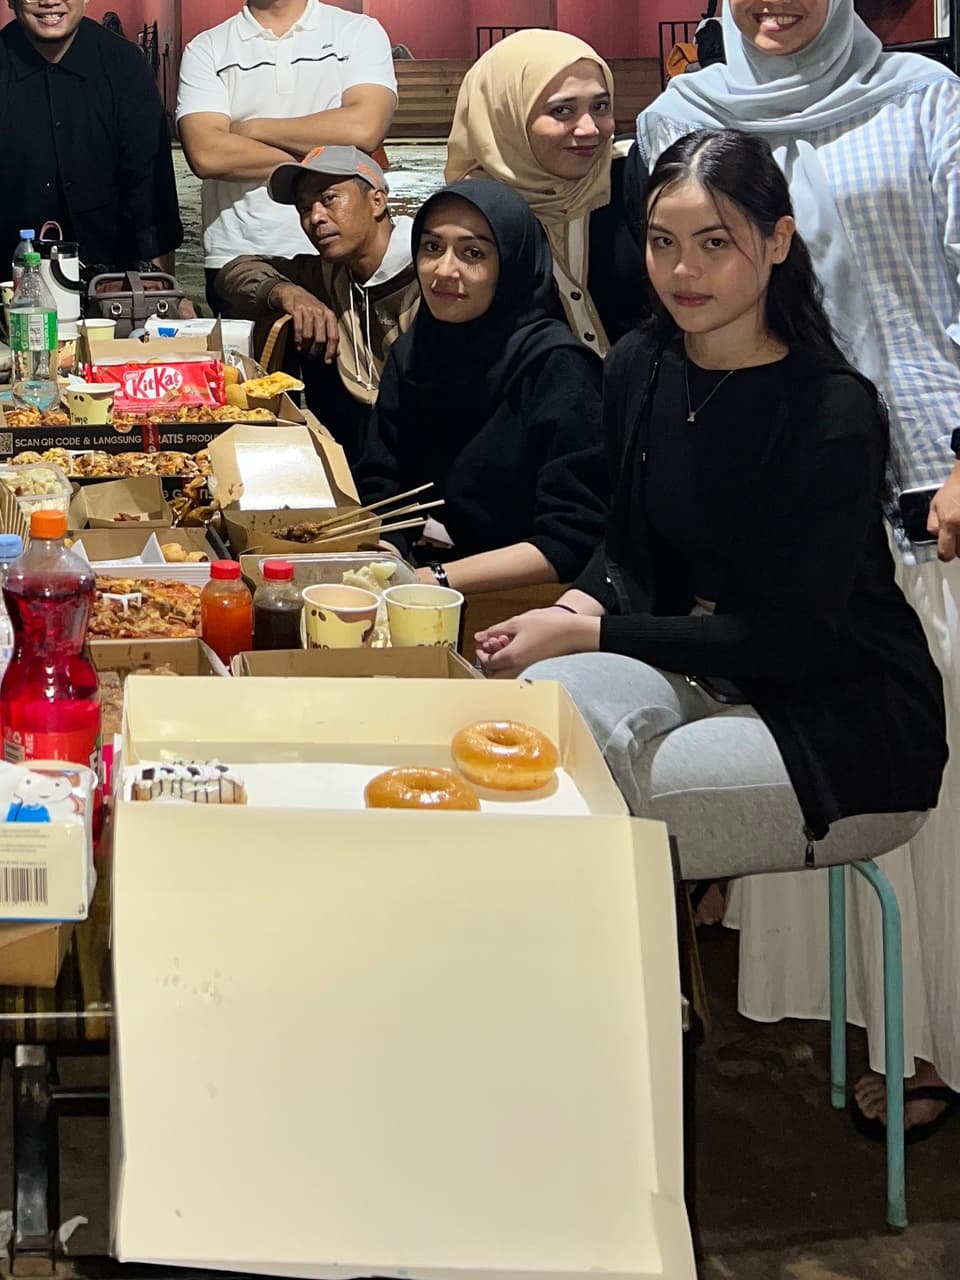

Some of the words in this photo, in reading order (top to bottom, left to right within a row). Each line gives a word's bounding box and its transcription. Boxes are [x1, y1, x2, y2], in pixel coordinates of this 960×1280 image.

[131, 367, 180, 398] KitKat
[15, 438, 39, 448] SCAN
[41, 437, 54, 446] QR
[55, 436, 80, 446] CODE
[83, 436, 91, 445] &
[93, 435, 142, 445] LANGSUNG
[185, 433, 218, 443] PRODU
